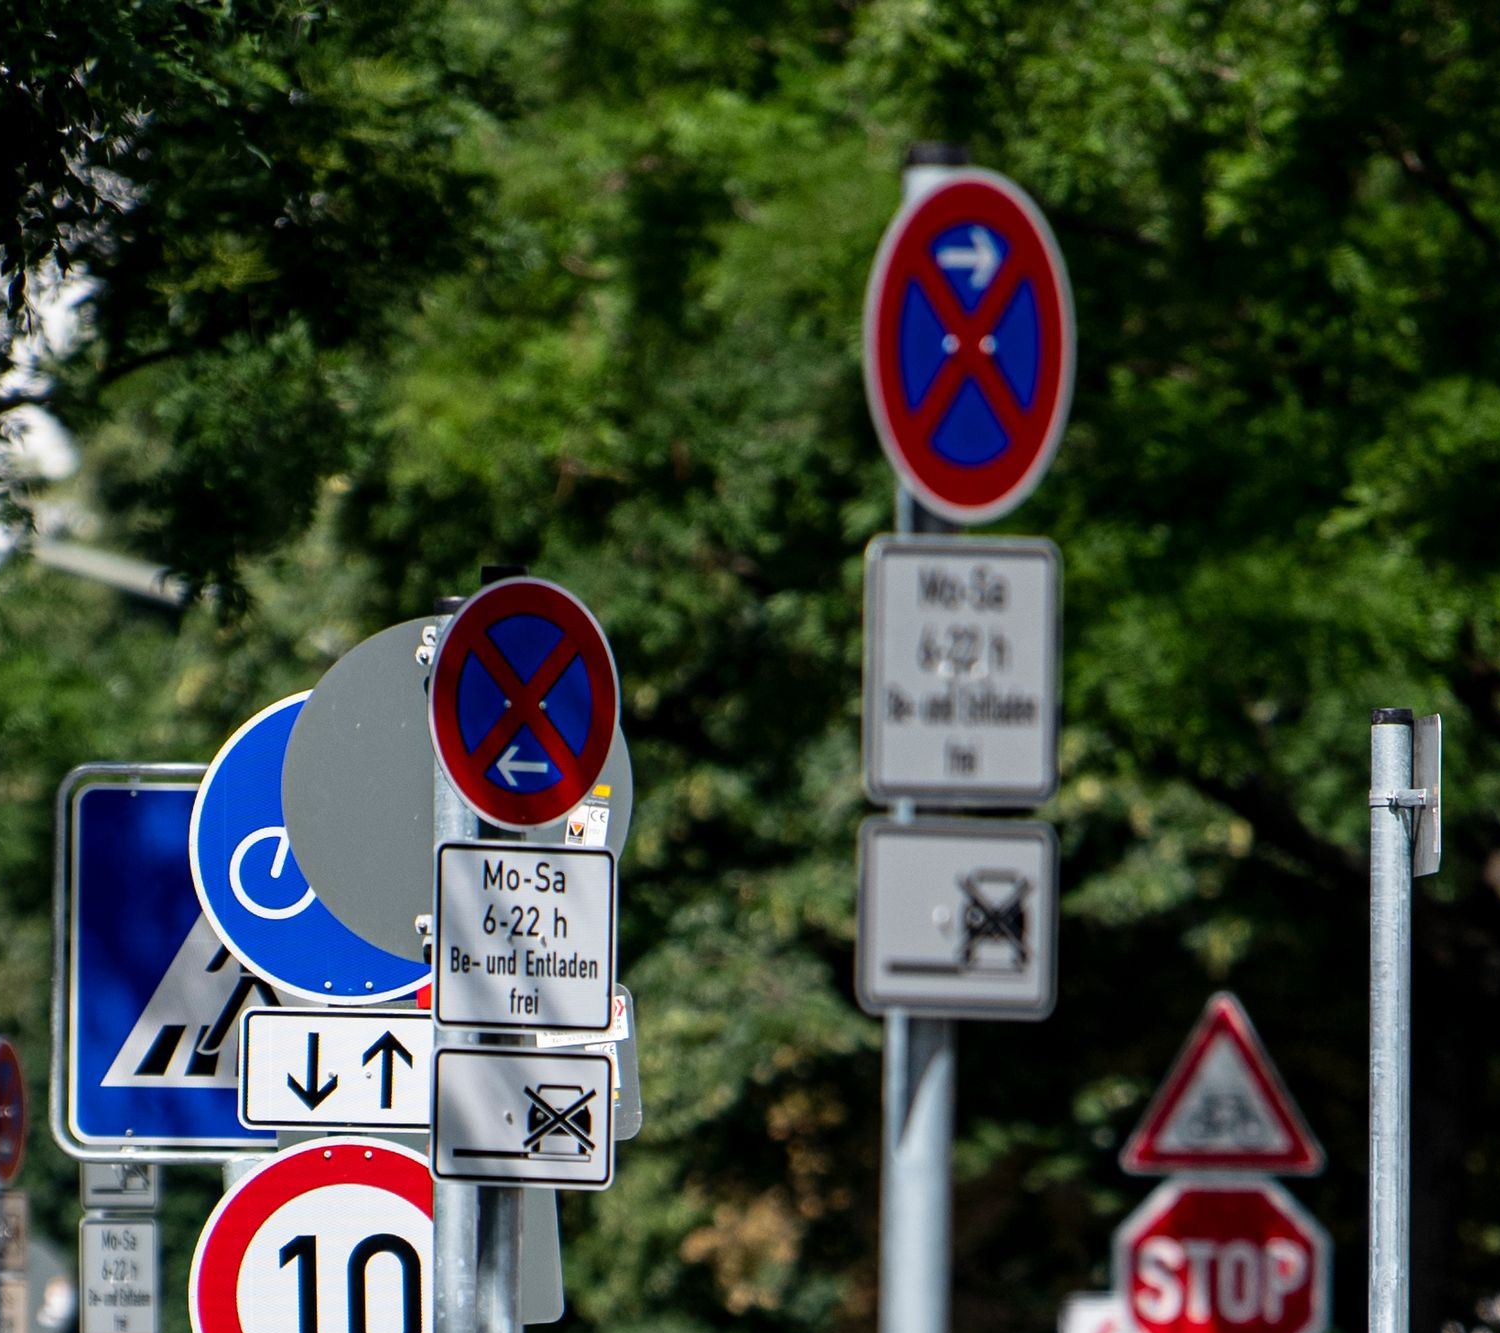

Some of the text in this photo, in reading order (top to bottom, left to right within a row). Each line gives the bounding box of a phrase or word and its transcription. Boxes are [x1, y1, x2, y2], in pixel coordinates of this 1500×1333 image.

[483, 859, 566, 893] Mo-Sa
[483, 904, 567, 939] 6-22 h
[450, 946, 598, 979] Be- und Entladen
[509, 987, 539, 1015] frei
[102, 1230, 136, 1250] Mo-Sa
[1136, 1235, 1306, 1325] STOP
